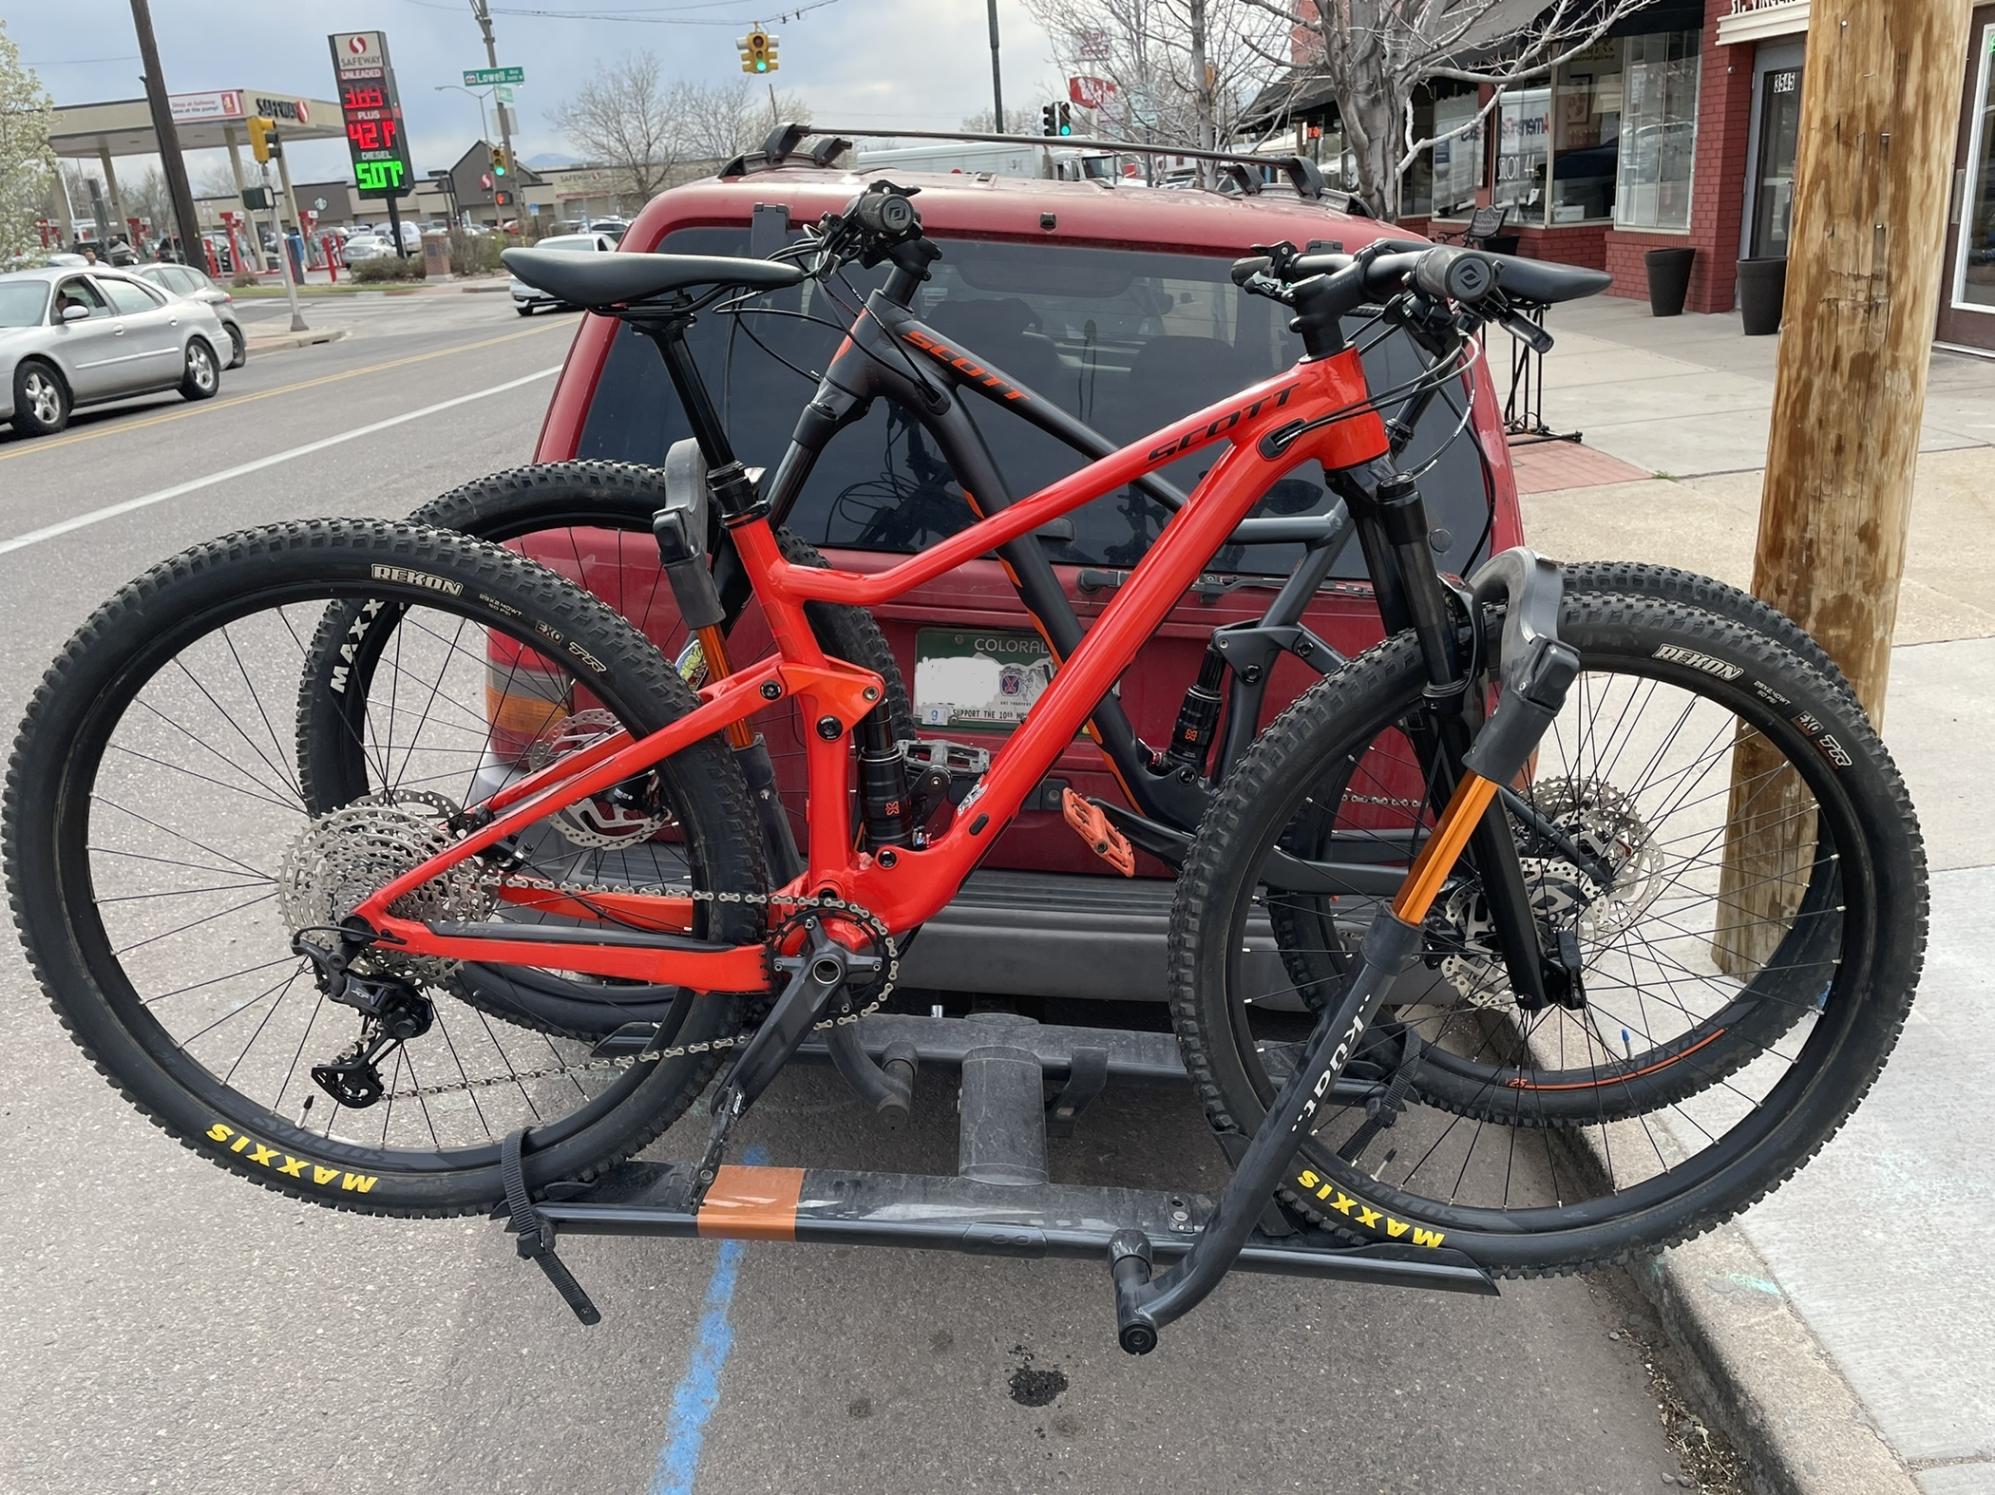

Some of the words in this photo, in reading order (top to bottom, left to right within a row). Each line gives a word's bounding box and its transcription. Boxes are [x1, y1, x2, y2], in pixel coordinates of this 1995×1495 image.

[341, 56, 381, 67] SAFEWAY
[341, 69, 381, 80] UNLEADED
[476, 71, 506, 83] Lowell
[1774, 72, 1796, 93] 3545
[357, 110, 380, 119] PLUS
[361, 151, 392, 160] DIESEL
[902, 330, 1029, 401] SCOTT
[1148, 383, 1301, 463] SCOTT
[371, 564, 463, 597] REKON
[330, 599, 385, 694] MAXX
[974, 638, 1051, 654] COLORA
[1651, 643, 1744, 682] REKON
[931, 710, 938, 721] 9
[952, 708, 980, 719] SUPPORT
[984, 710, 996, 719] THE
[206, 1123, 378, 1194] MAXXIS
[1297, 1169, 1445, 1248] MAXXIS
